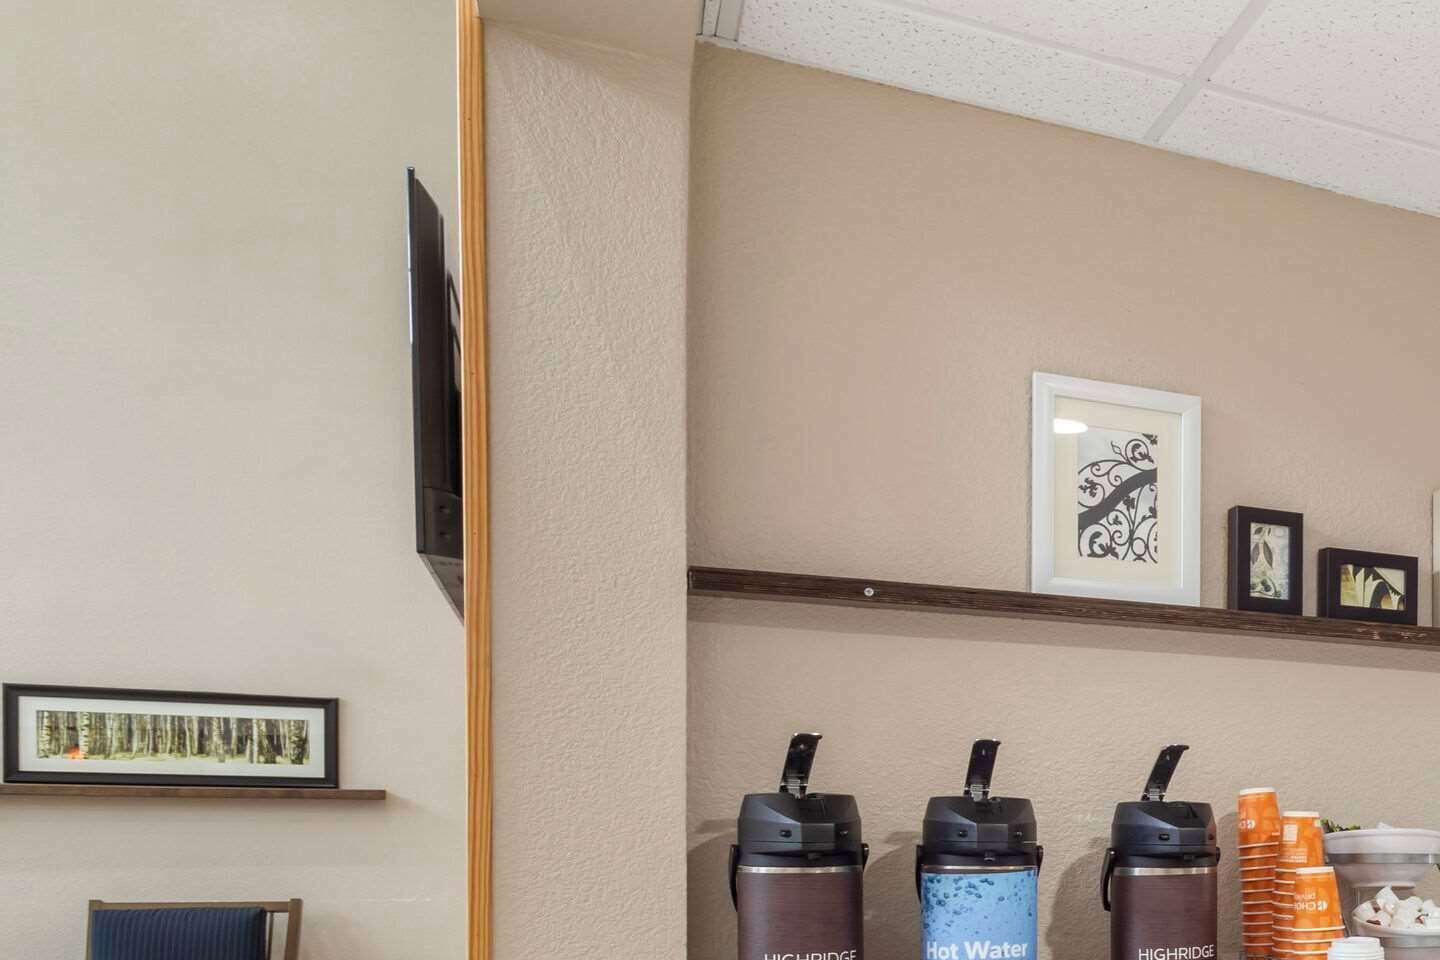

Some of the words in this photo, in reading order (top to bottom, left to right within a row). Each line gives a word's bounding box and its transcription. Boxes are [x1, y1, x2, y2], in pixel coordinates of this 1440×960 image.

[926, 941, 960, 960] Hot
[963, 940, 1029, 960] Water
[1138, 944, 1216, 960] HIGHRIDGE
